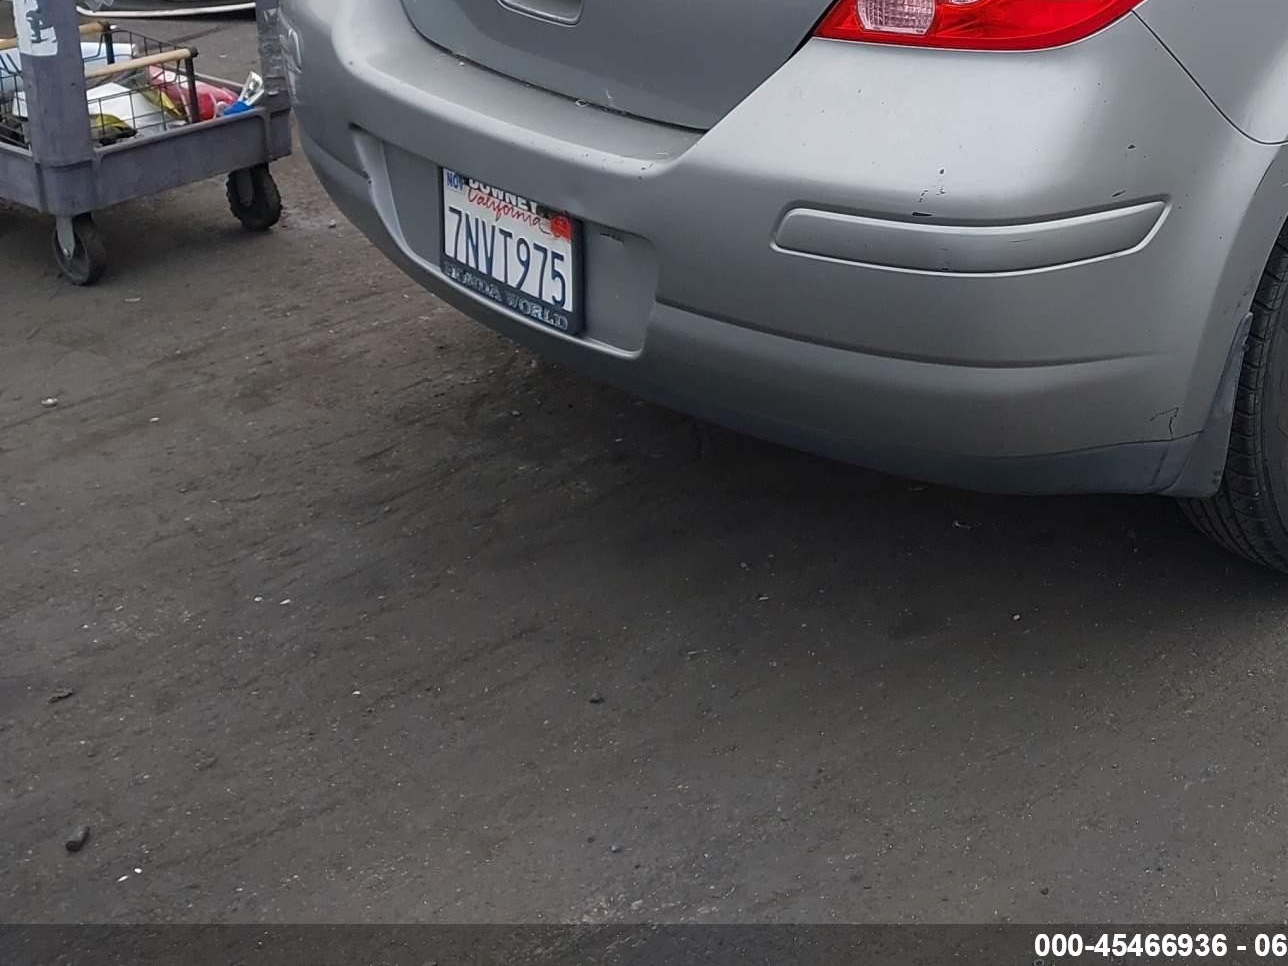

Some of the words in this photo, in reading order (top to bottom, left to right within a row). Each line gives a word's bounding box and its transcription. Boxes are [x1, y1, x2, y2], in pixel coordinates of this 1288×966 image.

[467, 186, 551, 234] California
[449, 206, 567, 308] 7NVT975
[506, 292, 569, 332] WORLD
